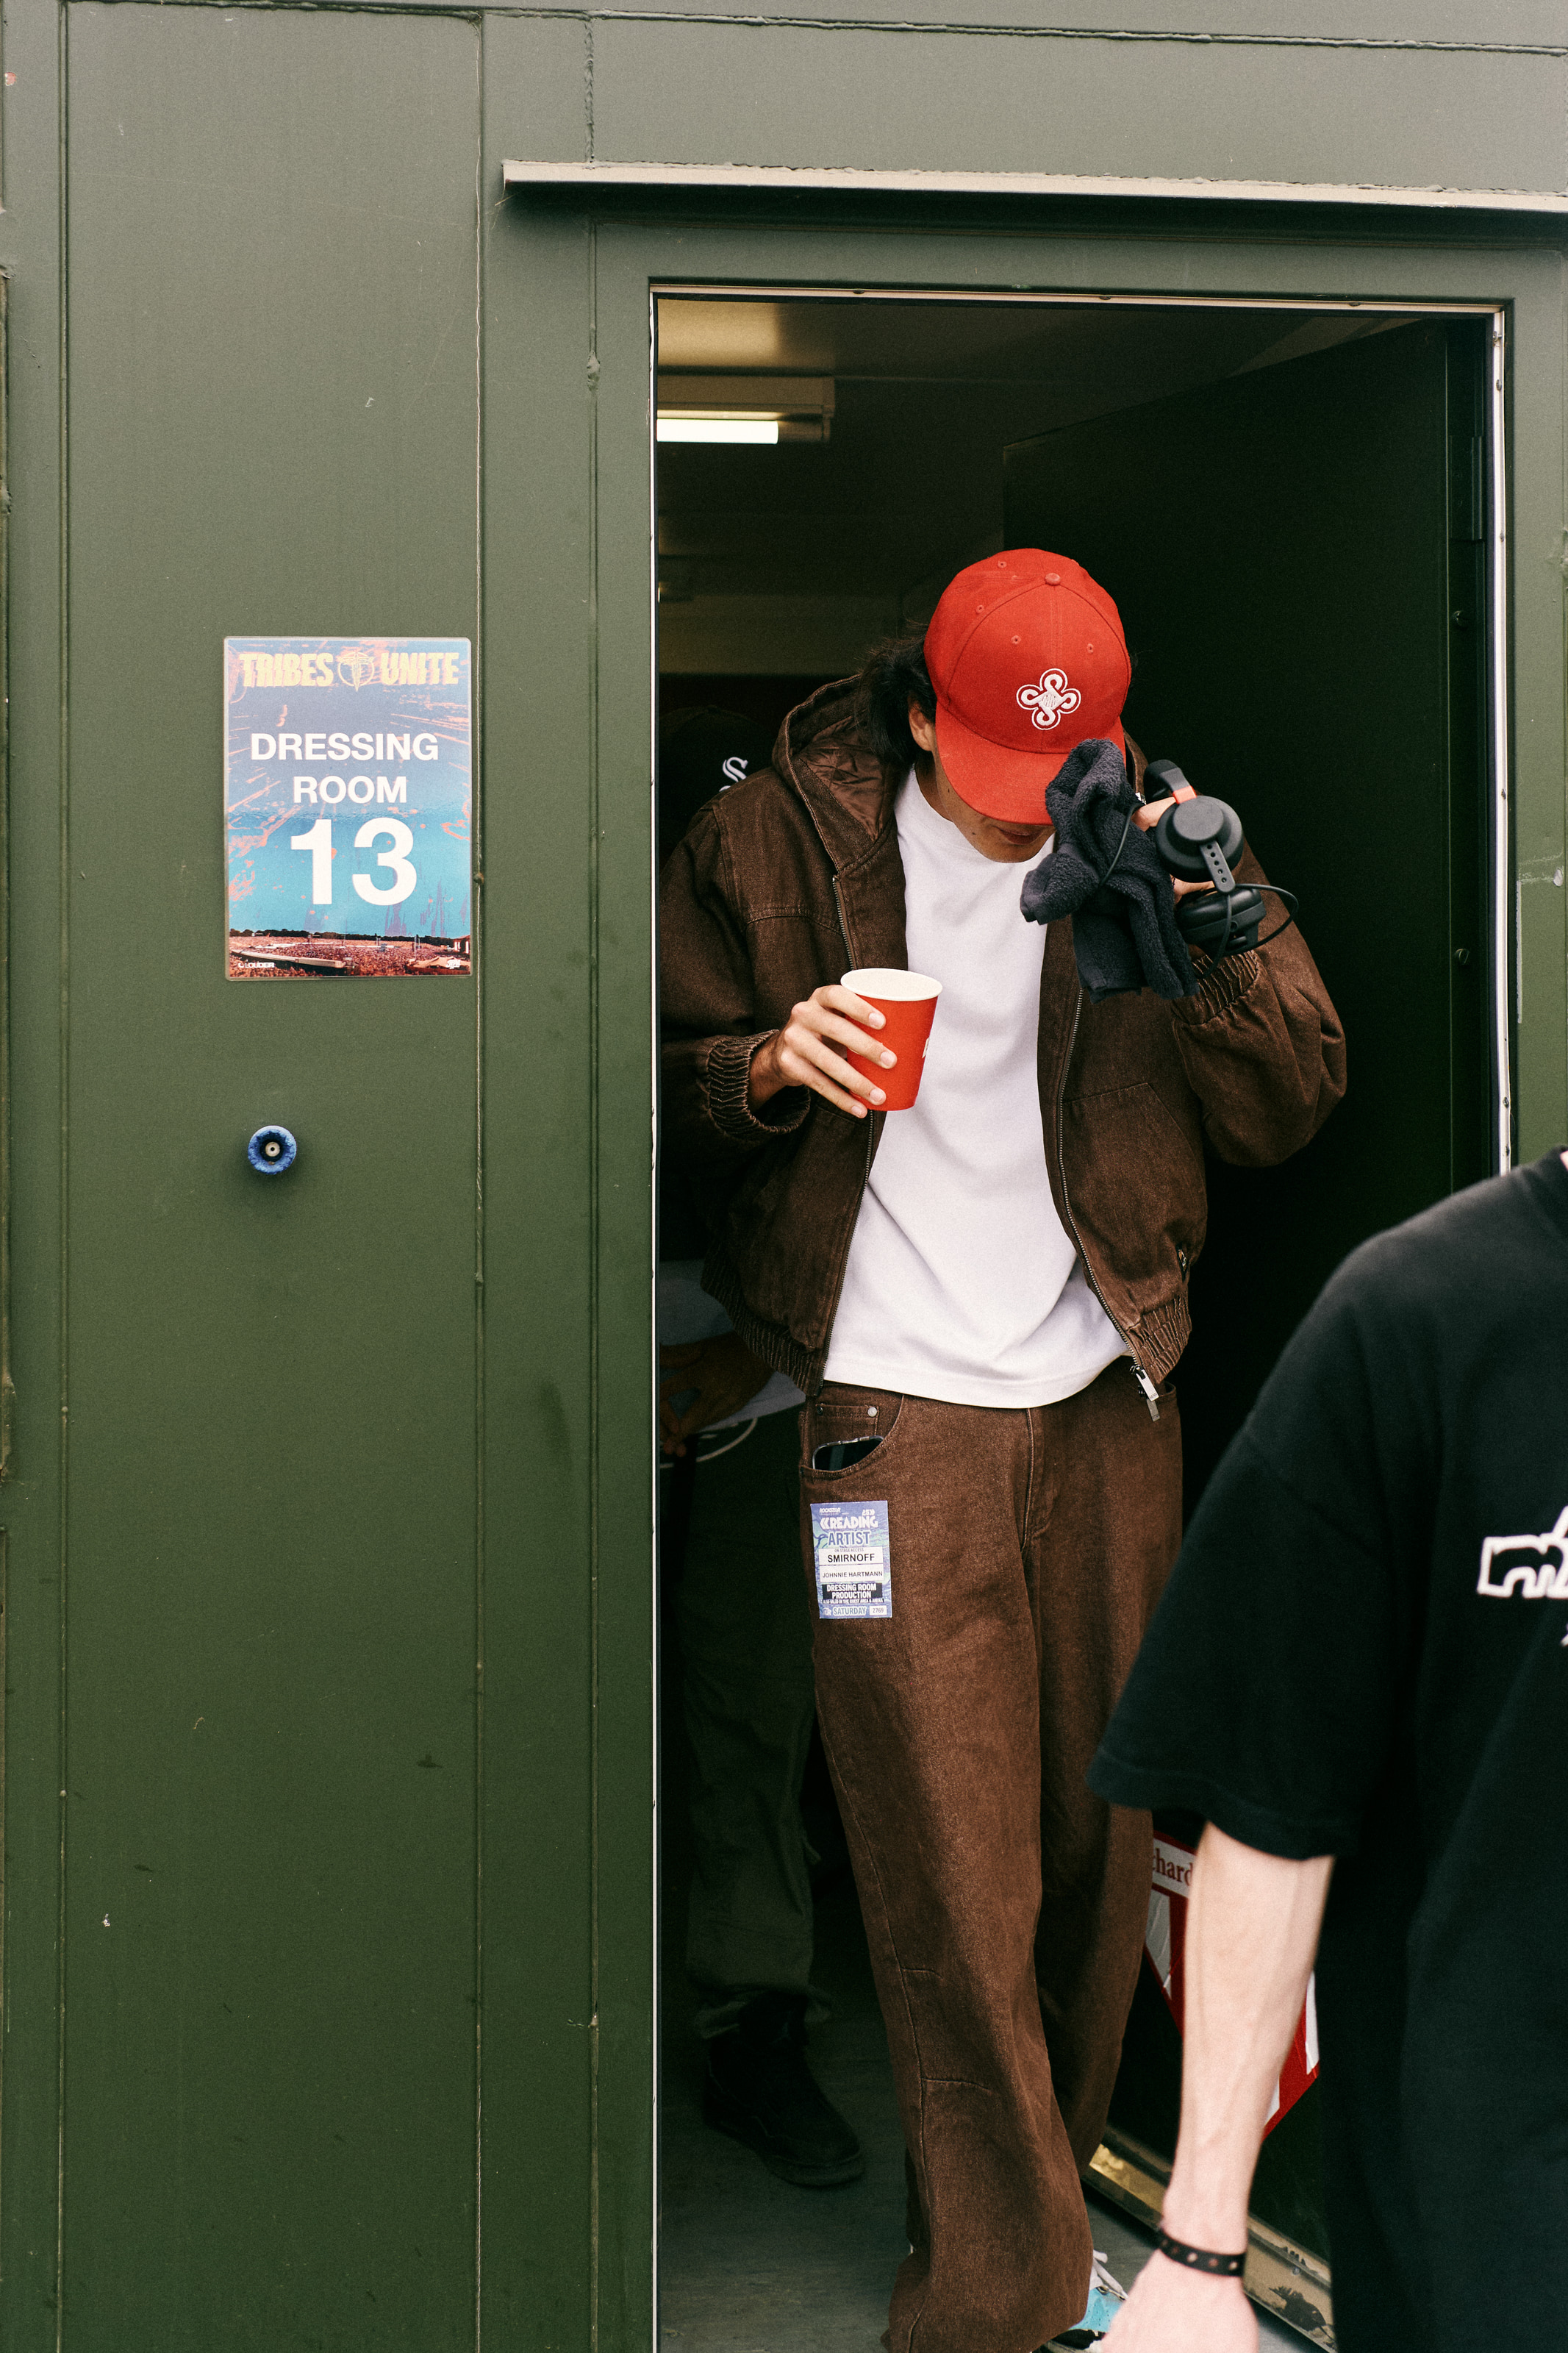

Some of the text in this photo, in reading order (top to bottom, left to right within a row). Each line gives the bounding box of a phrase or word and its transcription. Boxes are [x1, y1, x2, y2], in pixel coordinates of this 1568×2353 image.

[239, 652, 459, 688] TRIBES UNITE
[251, 733, 439, 761] DRESSING
[293, 776, 407, 804] ROOM
[290, 818, 418, 906] 13
[829, 1515, 878, 1529] READING
[828, 1531, 870, 1546] ARTIST
[828, 1553, 875, 1563] SMIRNOFF
[826, 1583, 877, 1592] DRESSING ROOM
[831, 1591, 872, 1599] PRODUCTION
[833, 1606, 867, 1615] SATURDAY
[1153, 1847, 1194, 1887] hard
